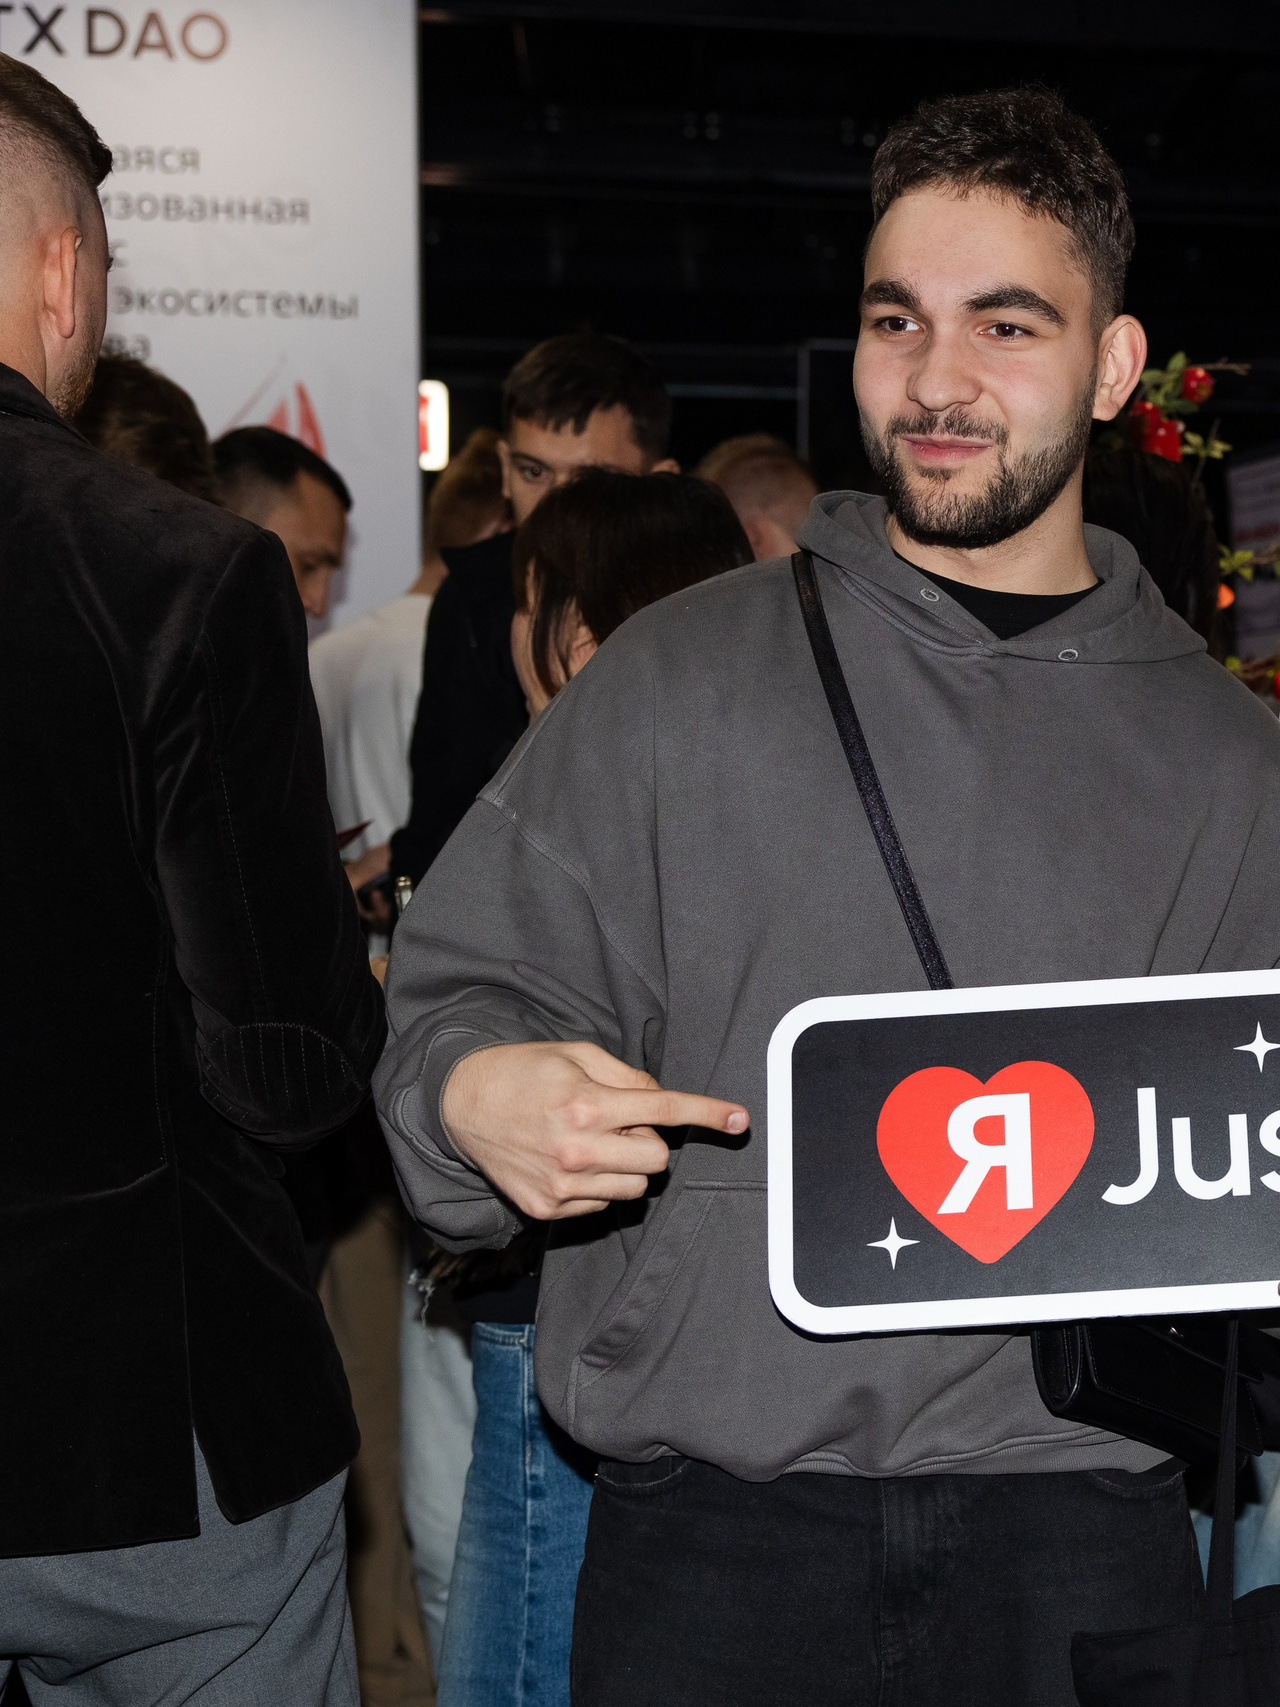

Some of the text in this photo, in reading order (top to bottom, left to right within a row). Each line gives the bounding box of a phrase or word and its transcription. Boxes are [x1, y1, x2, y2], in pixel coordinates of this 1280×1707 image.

[86, 9, 229, 62] DAO
[110, 287, 358, 319] экосистемы
[936, 1092, 1034, 1214] Я
